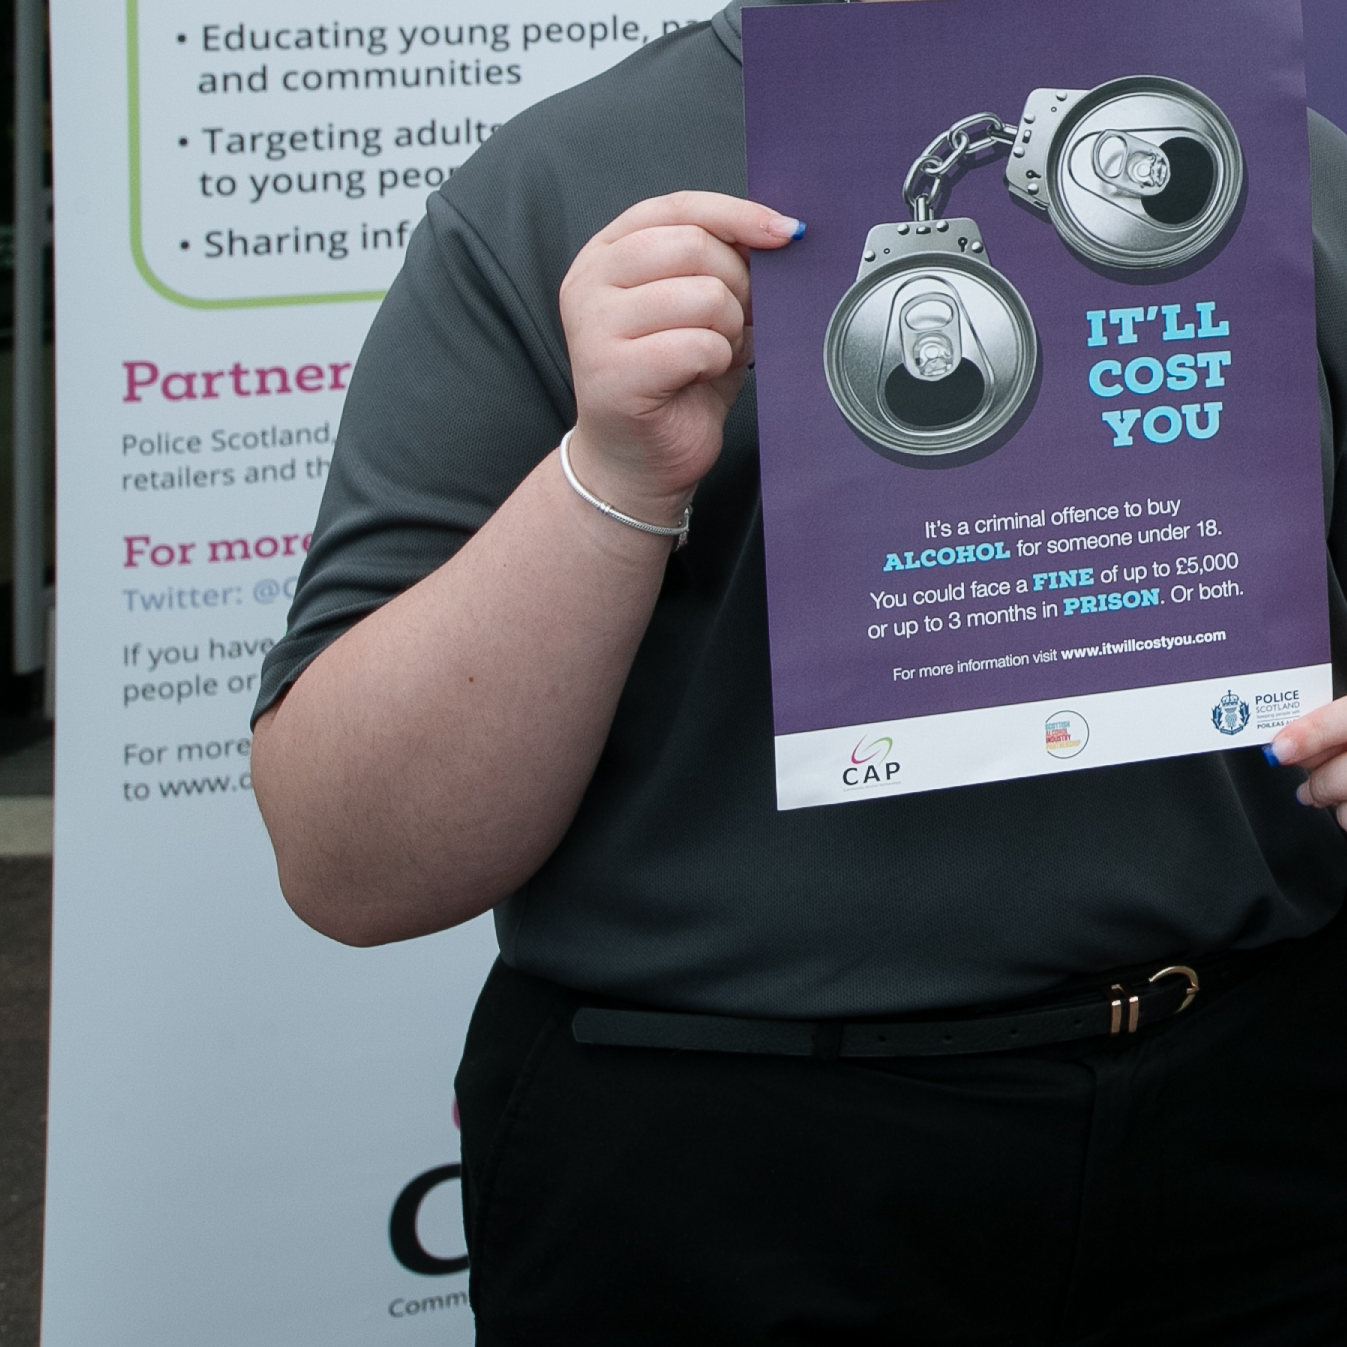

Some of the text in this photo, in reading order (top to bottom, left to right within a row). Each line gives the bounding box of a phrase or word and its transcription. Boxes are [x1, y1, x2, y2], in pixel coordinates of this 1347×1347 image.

[202, 21, 388, 56] Educating
[399, 24, 510, 55] young
[523, 14, 648, 52] people,
[198, 59, 521, 94] and communities
[202, 123, 383, 161] Targeting
[199, 171, 237, 197] to
[249, 170, 366, 204] young
[205, 220, 409, 260] Sharing inf
[1086, 301, 1230, 347] IT'LL
[1088, 350, 1232, 397] COST
[1101, 401, 1223, 447] YOU
[122, 432, 202, 457] Police
[122, 466, 236, 491] retailers
[244, 458, 296, 484] and
[122, 535, 196, 569] For
[883, 519, 1222, 572] ALCOHOL for someone under 18.
[122, 586, 243, 613] Twitter:
[123, 637, 275, 673] If you have
[893, 630, 1227, 681] For more information visit www.itwillcostyou.com
[123, 674, 257, 707] people or
[1255, 689, 1300, 705] POLICE
[1255, 701, 1300, 714] SCOTLAND
[123, 737, 251, 766] For more
[842, 761, 901, 786] CAP
[123, 782, 150, 802] to
